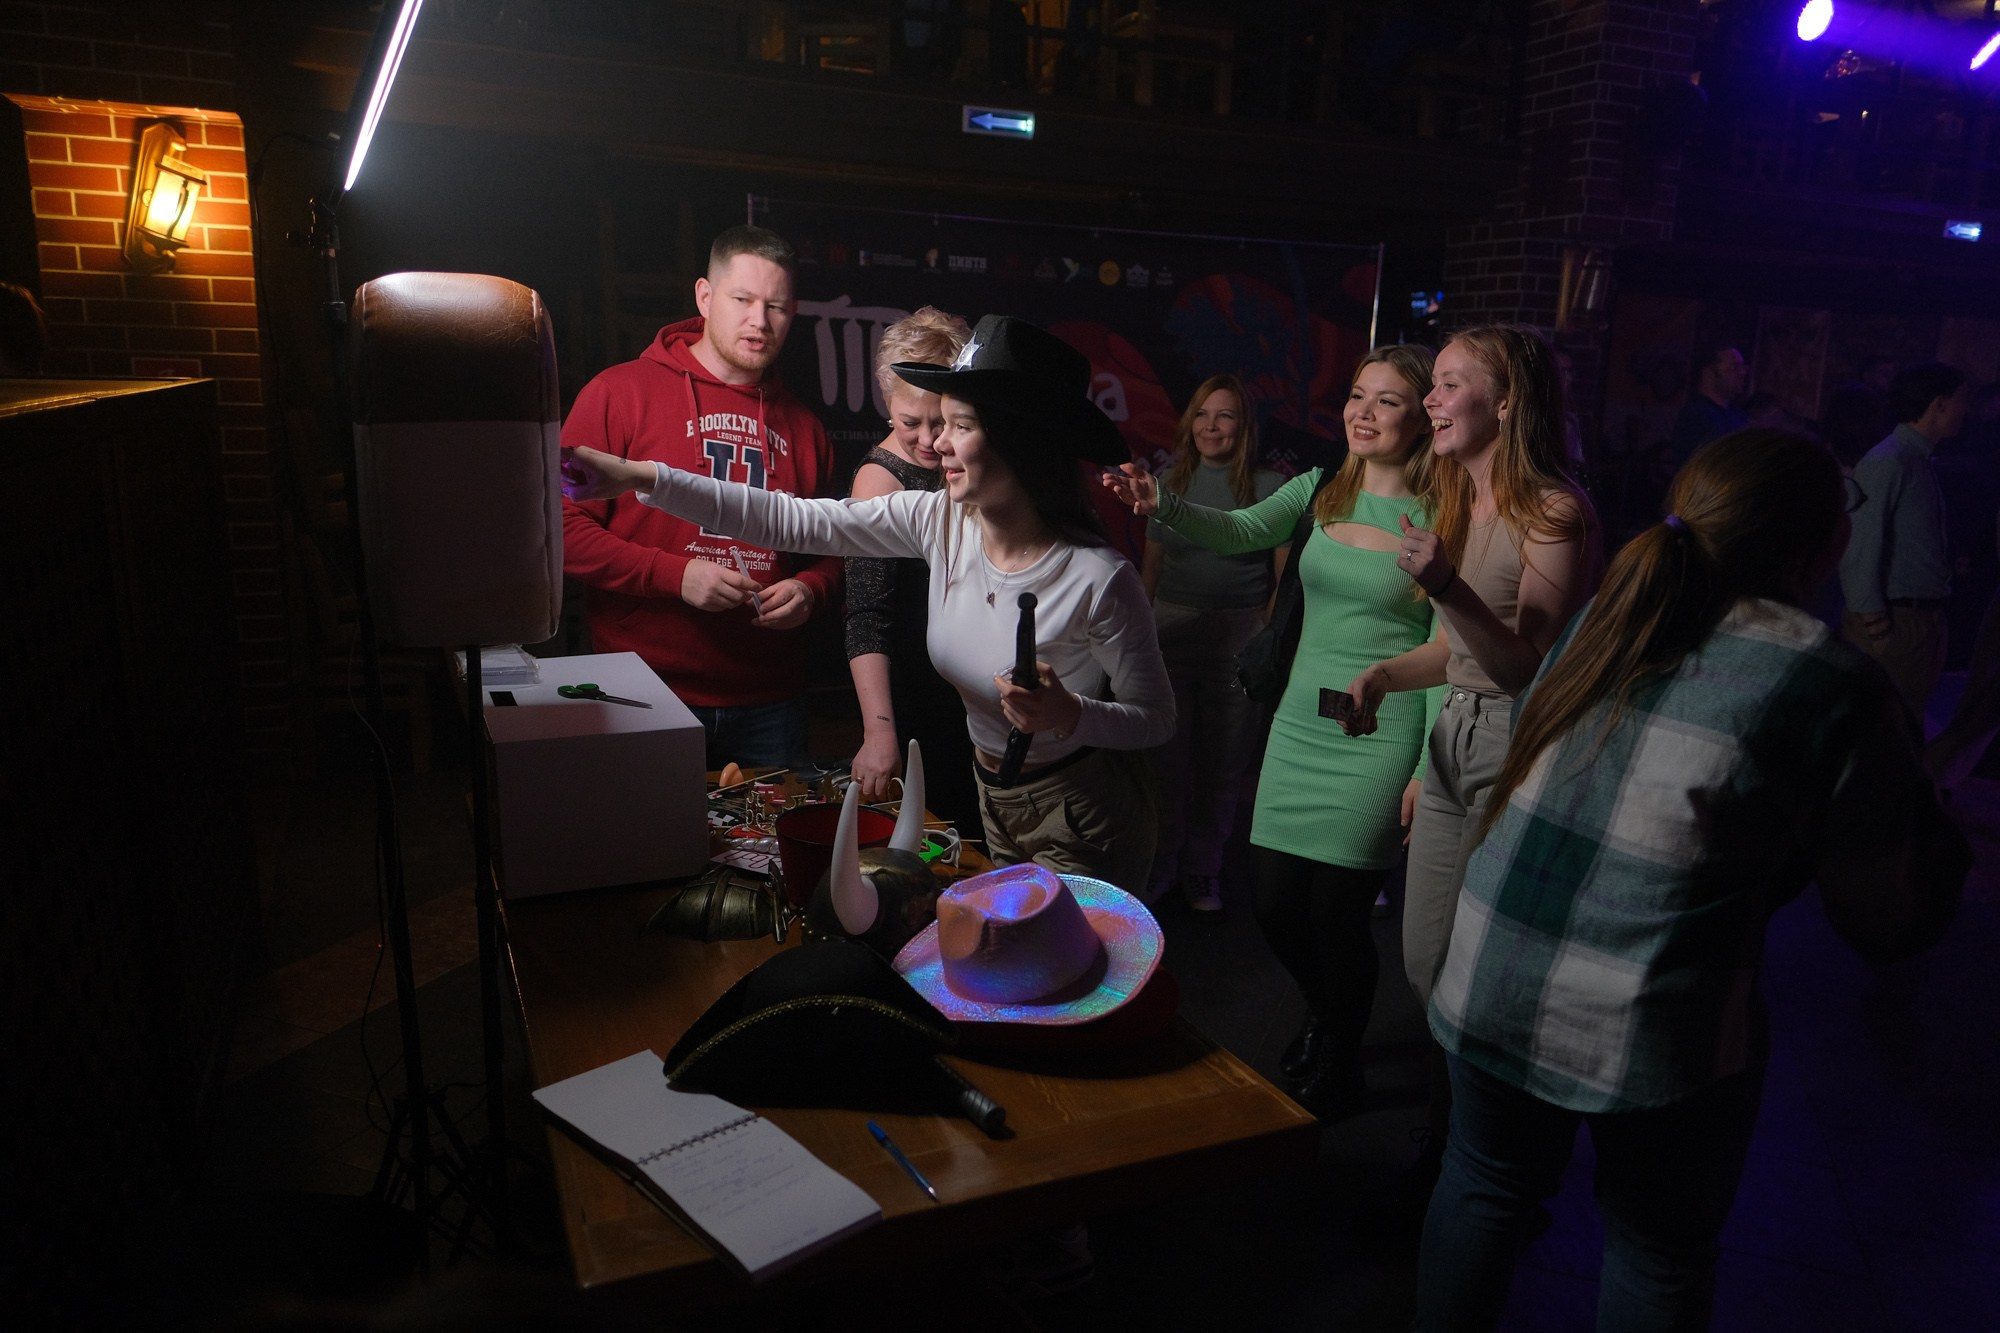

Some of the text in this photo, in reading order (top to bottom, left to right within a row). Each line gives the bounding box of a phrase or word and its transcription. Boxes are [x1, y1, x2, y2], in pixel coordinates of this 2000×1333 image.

[686, 413, 788, 456] BROOKLYN NYC
[717, 431, 762, 447] LEGEND TEAM
[684, 541, 727, 555] American
